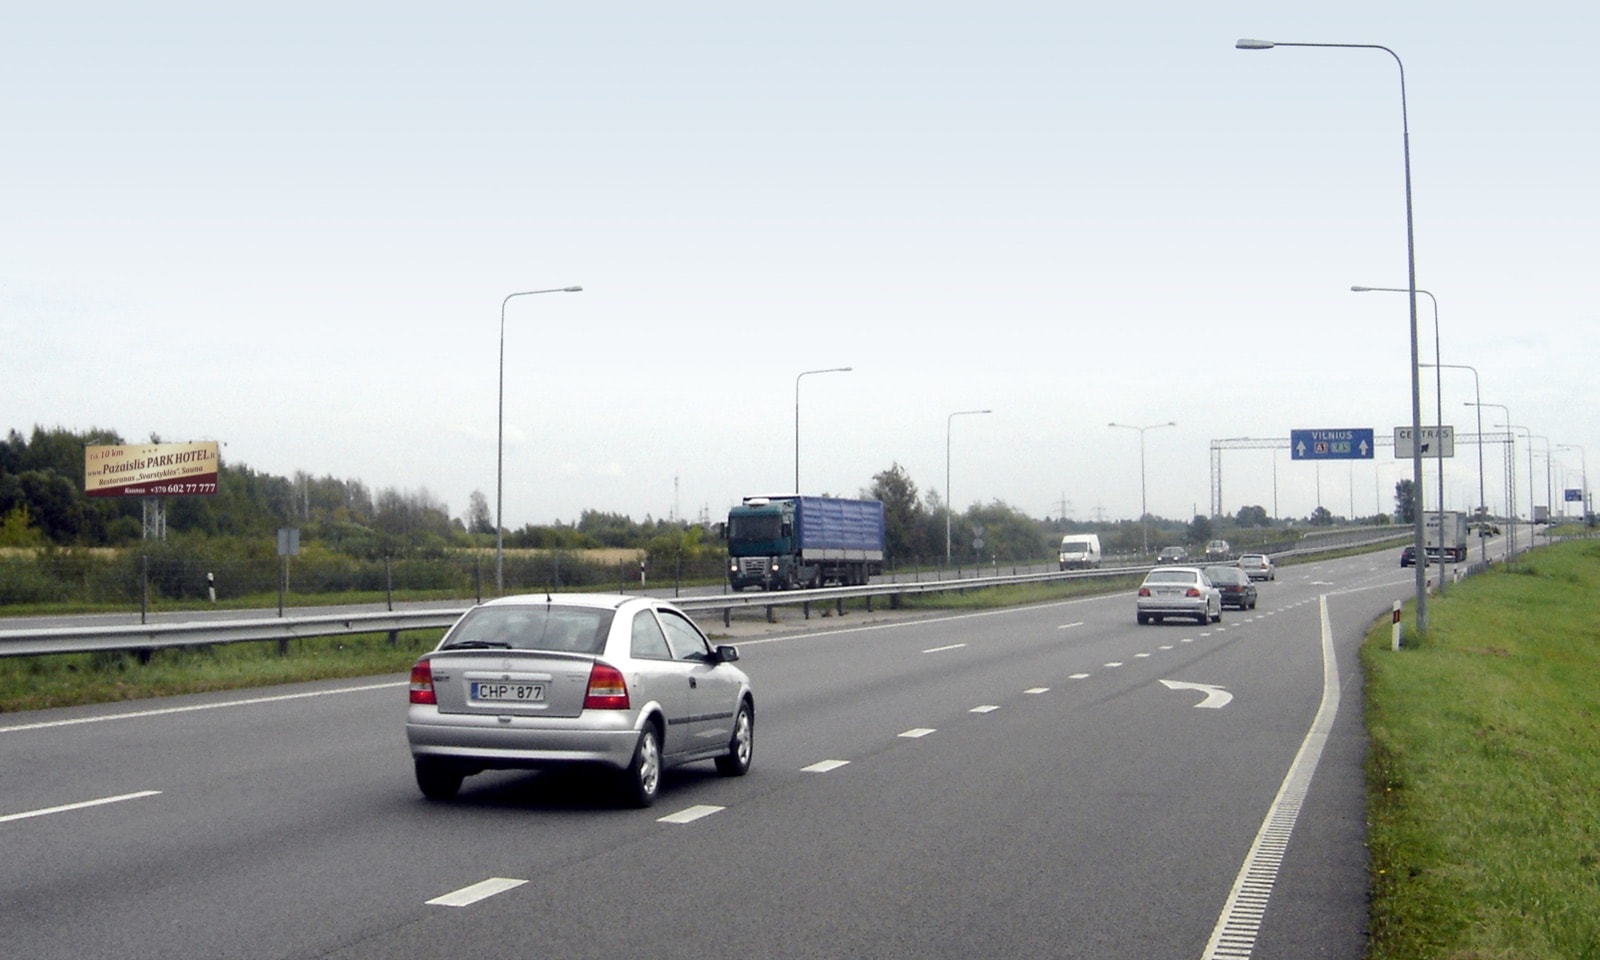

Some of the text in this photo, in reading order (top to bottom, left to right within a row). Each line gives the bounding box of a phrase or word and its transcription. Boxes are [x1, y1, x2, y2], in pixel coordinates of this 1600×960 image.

[1311, 431, 1353, 440] VILNIUS
[1400, 430, 1449, 439] CETRAS
[101, 450, 110, 459] 10
[111, 449, 124, 457] km
[147, 453, 174, 468] PARK
[98, 475, 135, 486] Restoranas
[182, 465, 204, 475] Sauna
[150, 485, 167, 494] +370
[167, 483, 185, 494] 602
[186, 483, 198, 493] 77
[199, 483, 216, 493] 777
[479, 685, 542, 699] CHP 877
